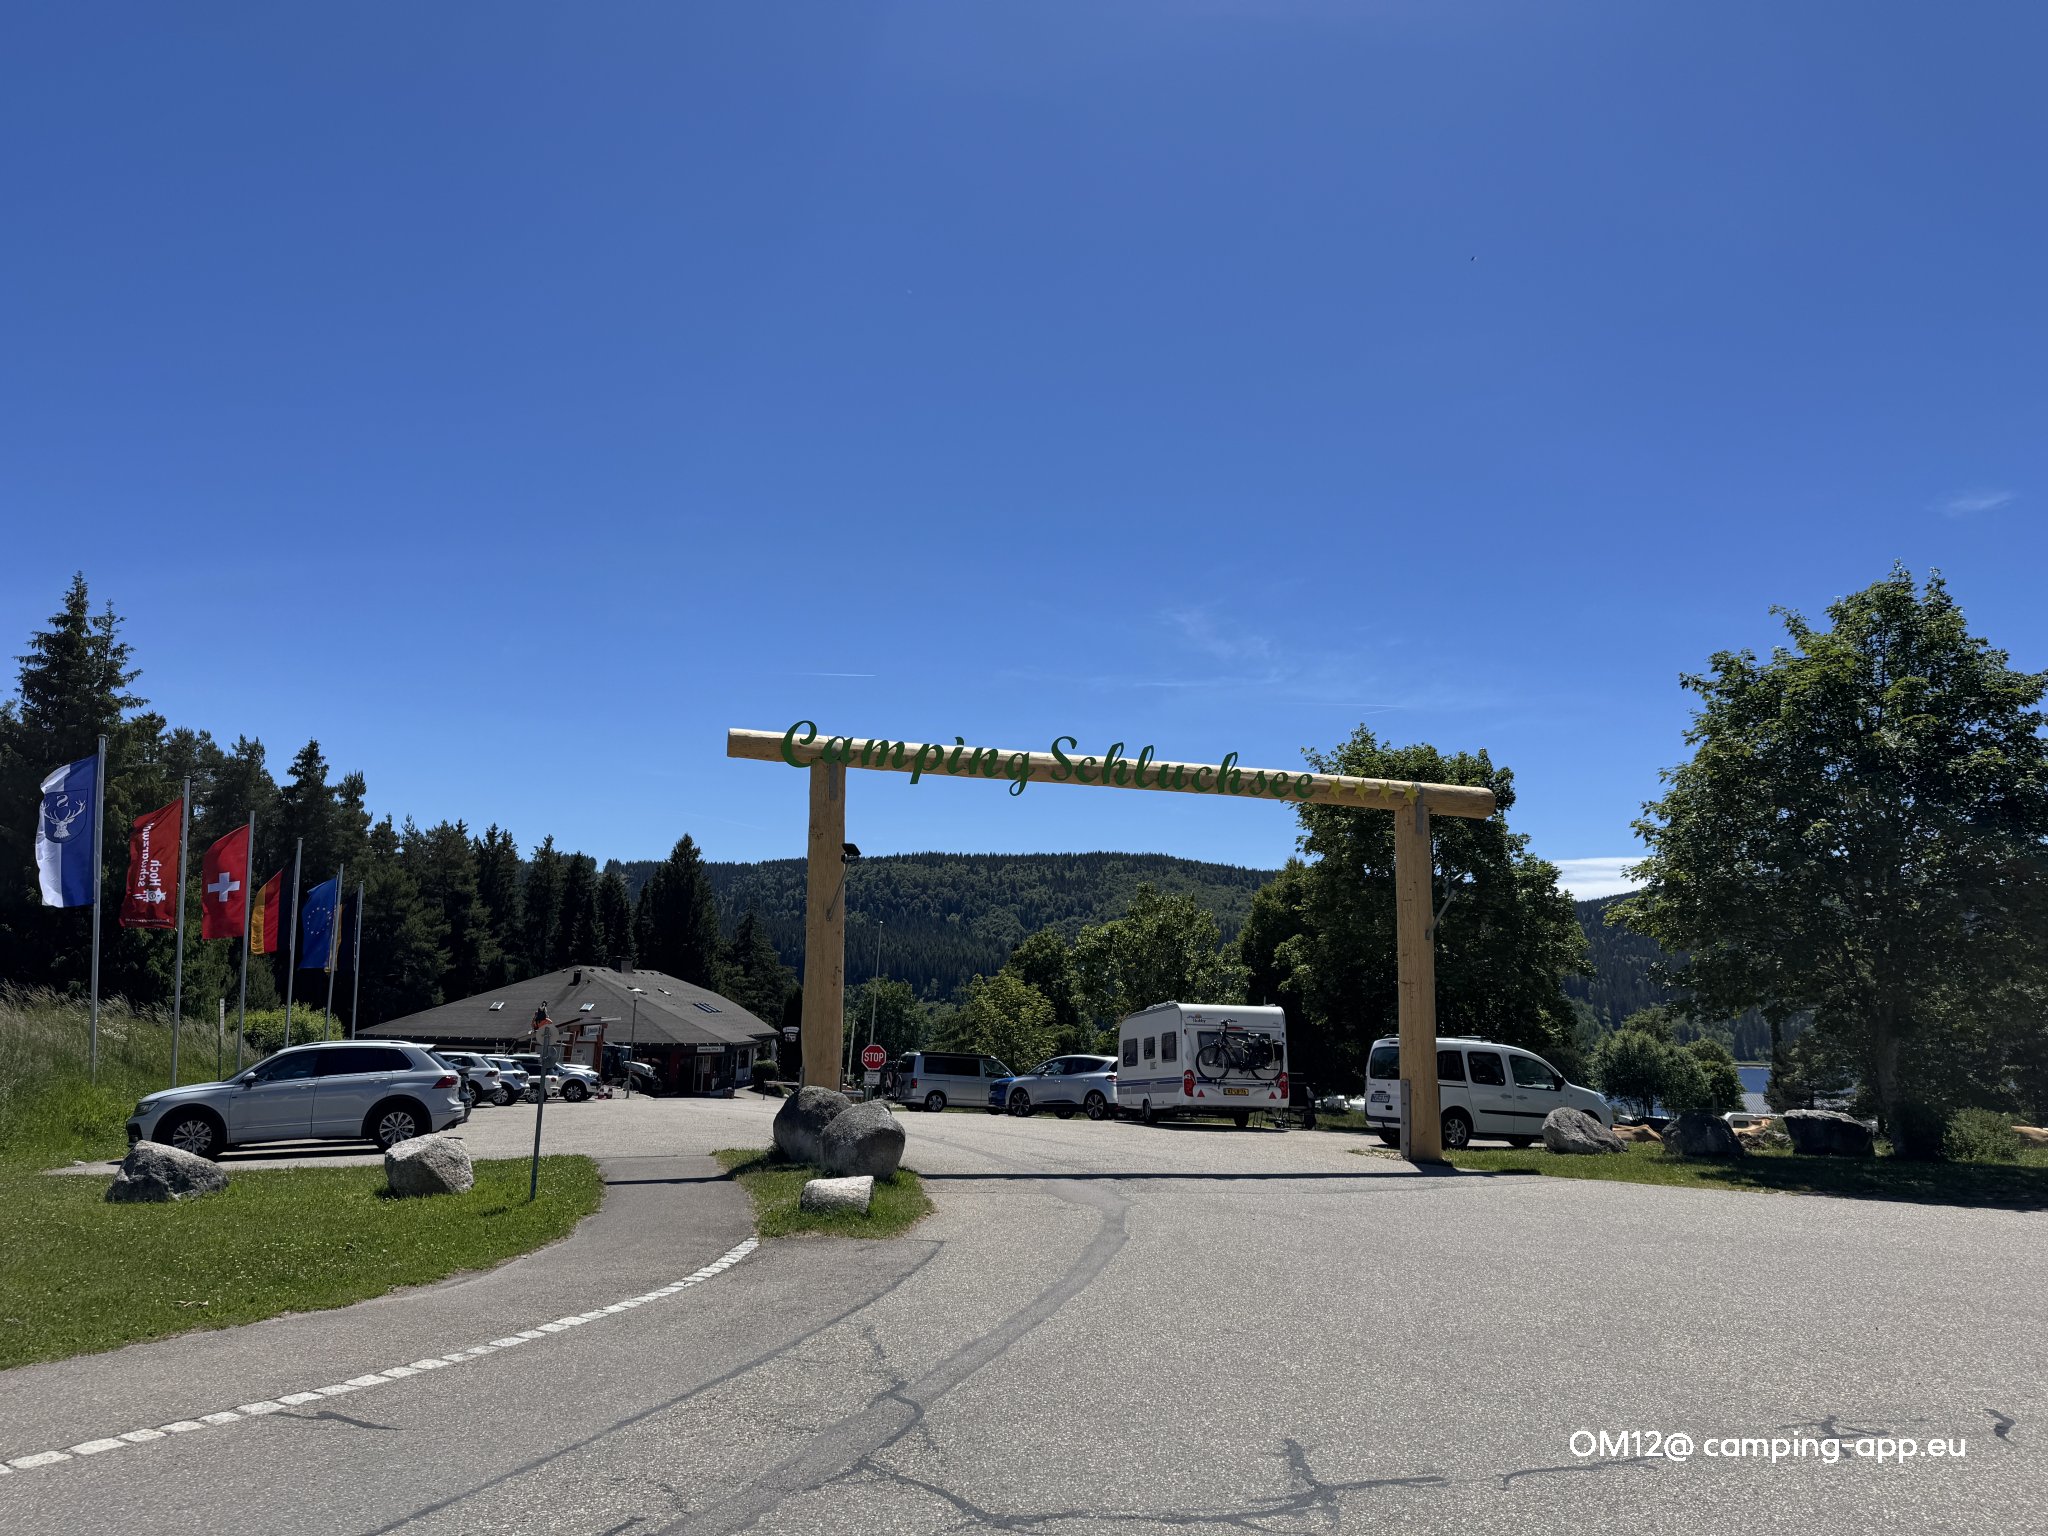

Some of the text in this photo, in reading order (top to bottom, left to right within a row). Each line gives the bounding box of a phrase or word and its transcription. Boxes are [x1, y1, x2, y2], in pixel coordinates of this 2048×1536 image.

[781, 720, 1315, 799] Camping Schluchsee
[864, 1052, 884, 1062] STOP
